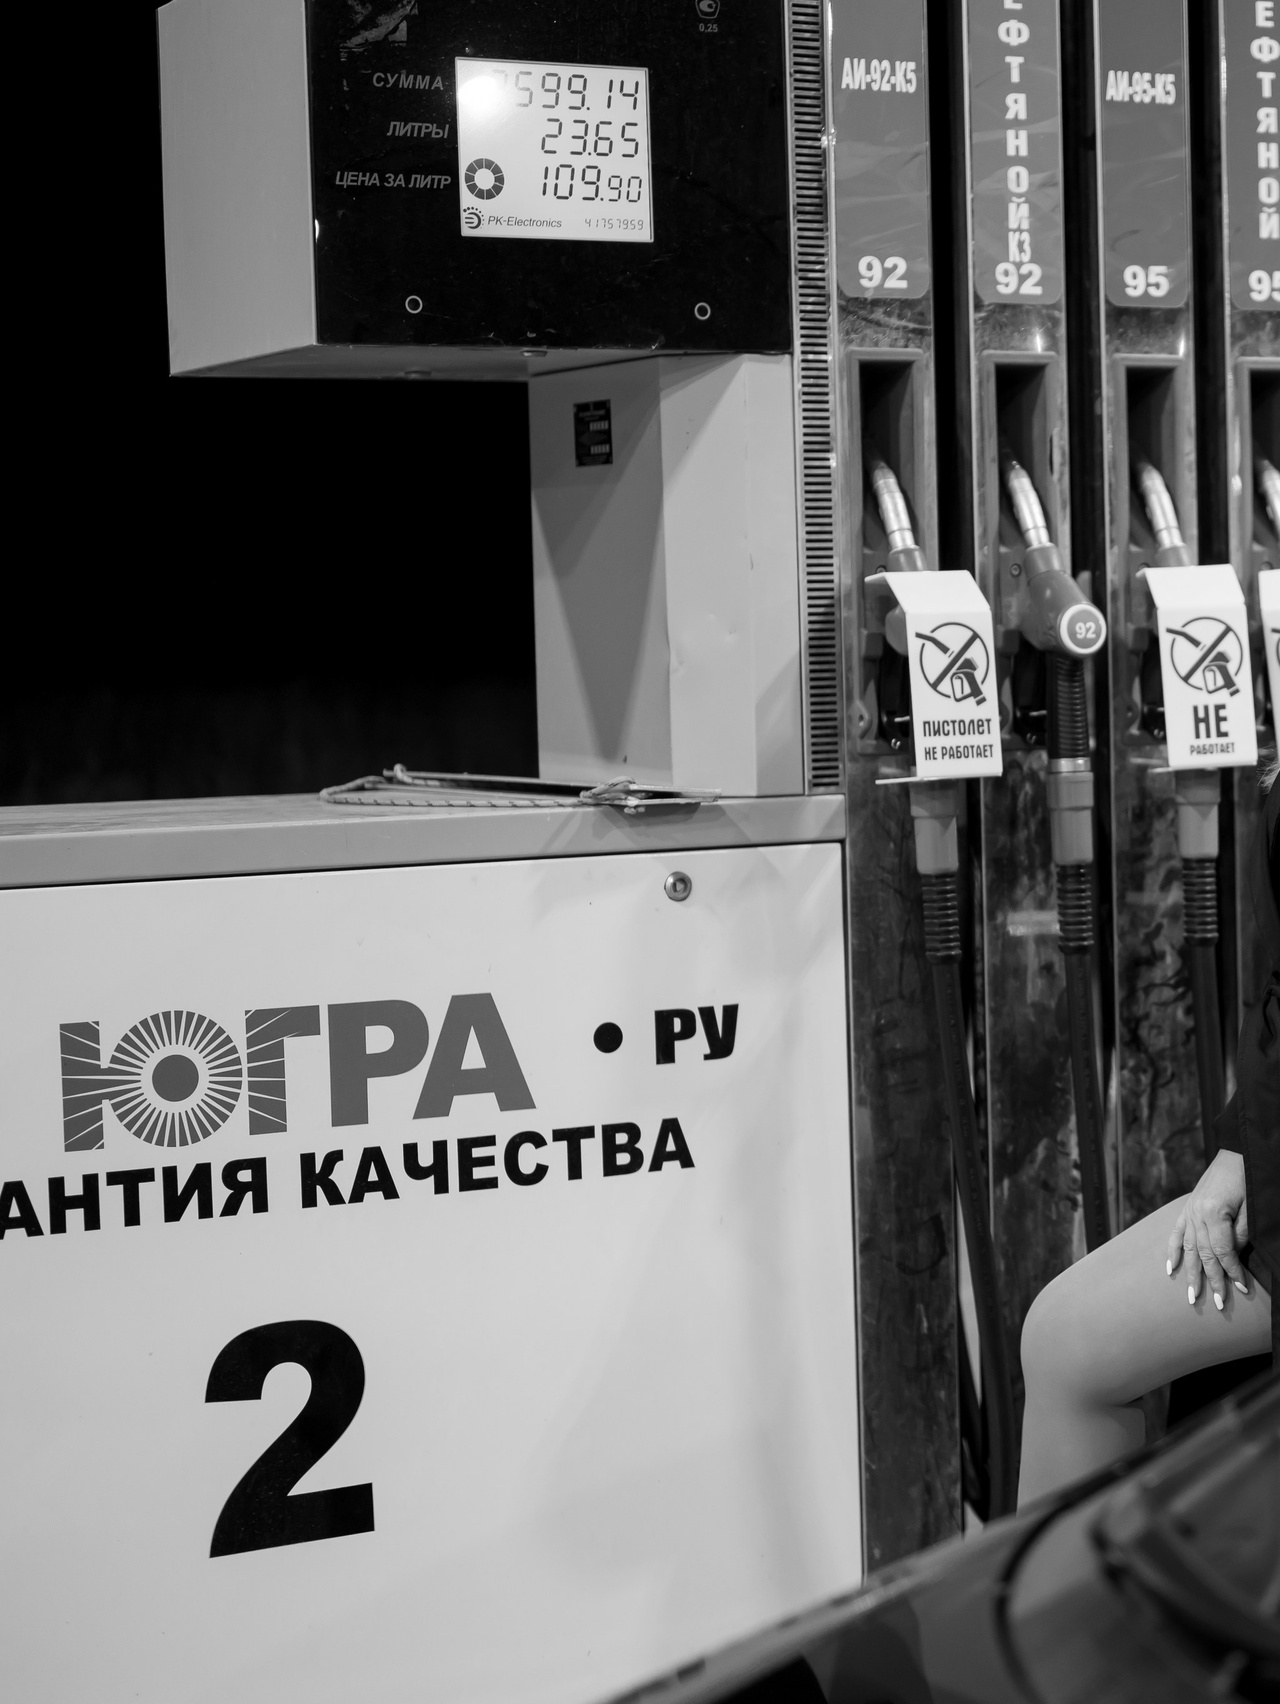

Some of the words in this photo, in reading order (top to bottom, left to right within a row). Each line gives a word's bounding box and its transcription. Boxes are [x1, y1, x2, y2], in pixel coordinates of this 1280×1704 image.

[372, 72, 444, 90] СУММА
[841, 57, 917, 93] АИ-92-К5
[386, 121, 450, 139] ЛИТРЫ
[541, 117, 639, 158] 23.65
[335, 171, 380, 189] ЦЕНА
[383, 173, 406, 188] ЗА
[408, 174, 452, 189] ЛИТР
[541, 164, 643, 203] 109.90
[487, 215, 563, 229] PK-Electronics
[857, 256, 908, 290] 92
[995, 262, 1043, 296] 92
[1123, 265, 1170, 298] 95
[1075, 622, 1097, 639] 92
[1193, 703, 1230, 740] НЕ
[924, 746, 938, 761] НЕ
[941, 744, 994, 760] РАБОТАЕТ
[1190, 742, 1235, 756] РАБОТАЕТ
[59, 993, 537, 1152] ЮГРА
[0, 1156, 269, 1241] АНТИЯ
[300, 1118, 696, 1210] КАЧЕСТВА
[205, 1319, 376, 1559] 2
